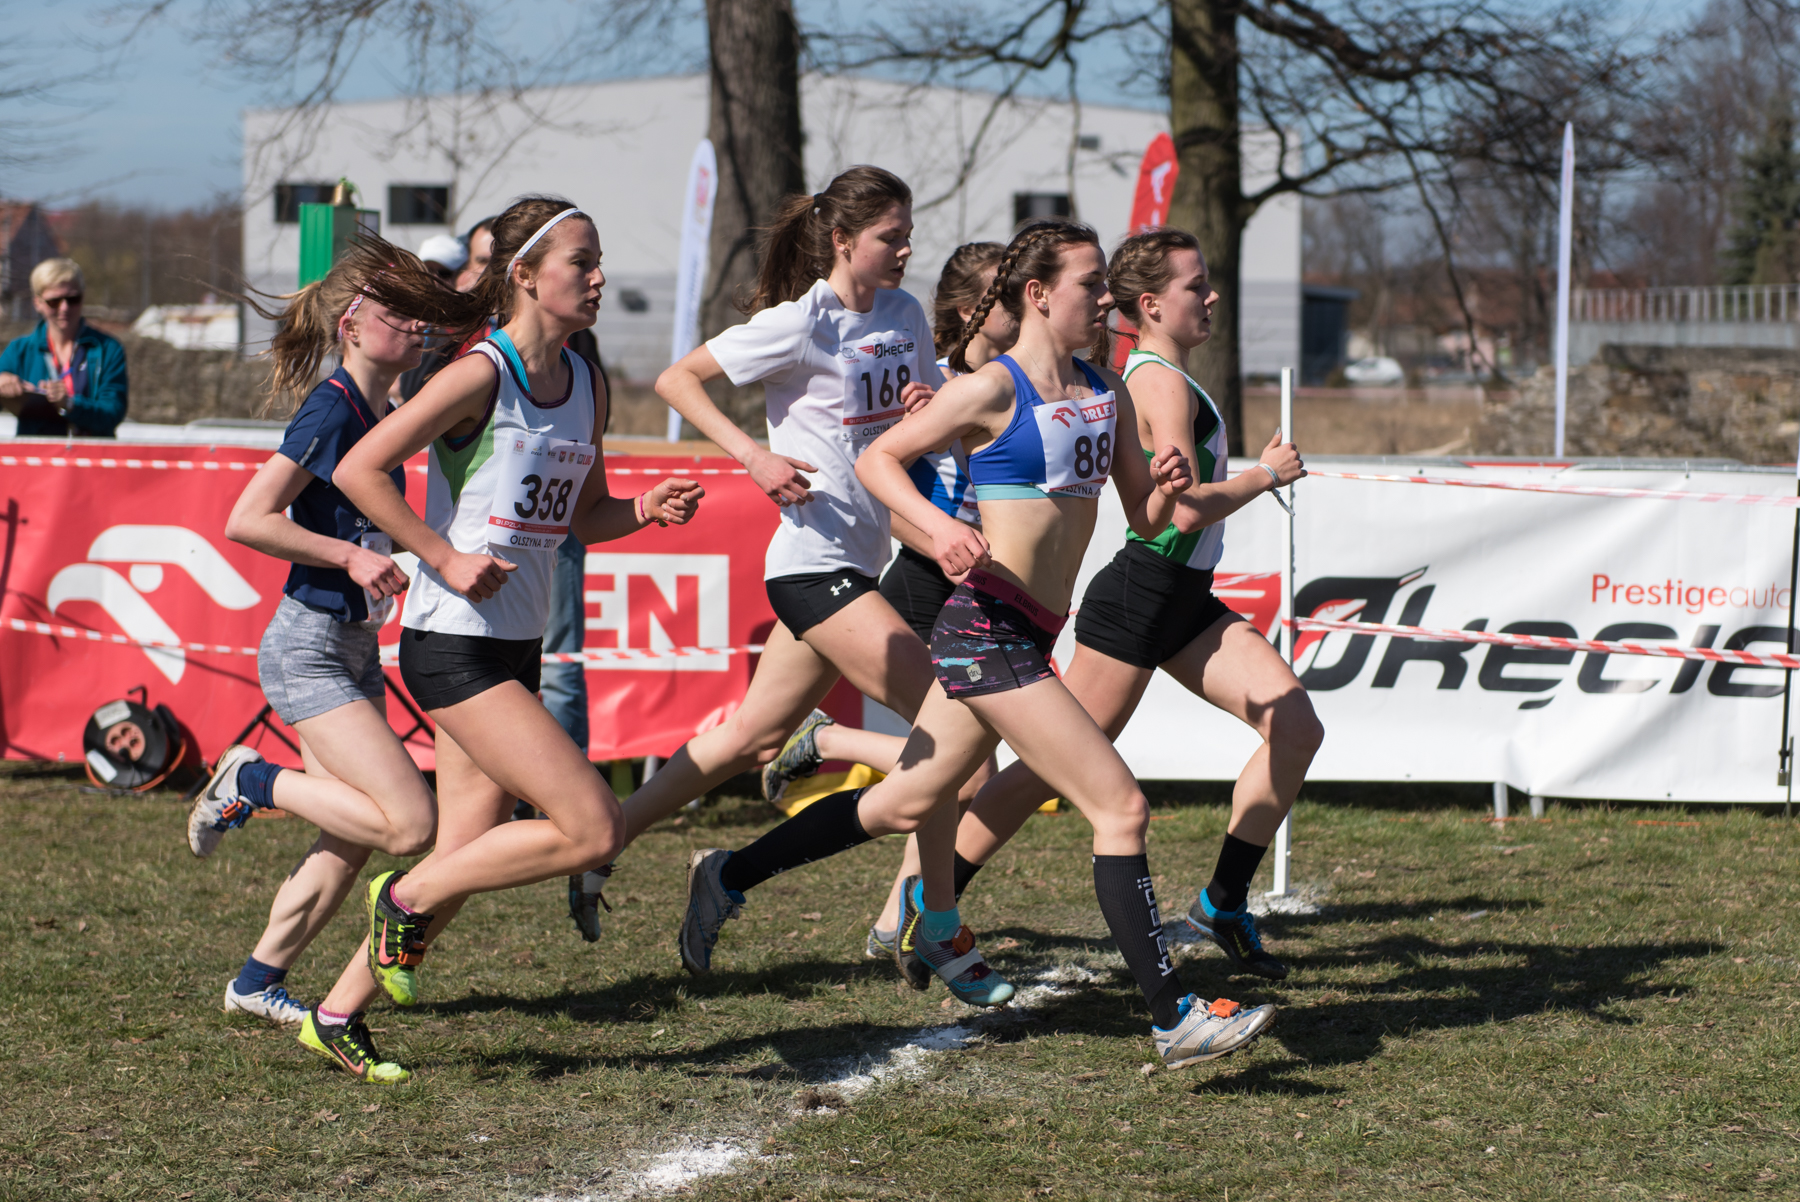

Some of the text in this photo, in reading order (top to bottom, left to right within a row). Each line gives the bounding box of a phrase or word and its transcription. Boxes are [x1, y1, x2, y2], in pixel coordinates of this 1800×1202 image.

[860, 364, 911, 411] 168
[1074, 432, 1111, 479] 88
[514, 474, 573, 522] 358
[510, 535, 557, 548] OLSZYNA 2019
[1014, 593, 1039, 617] ELBRUS
